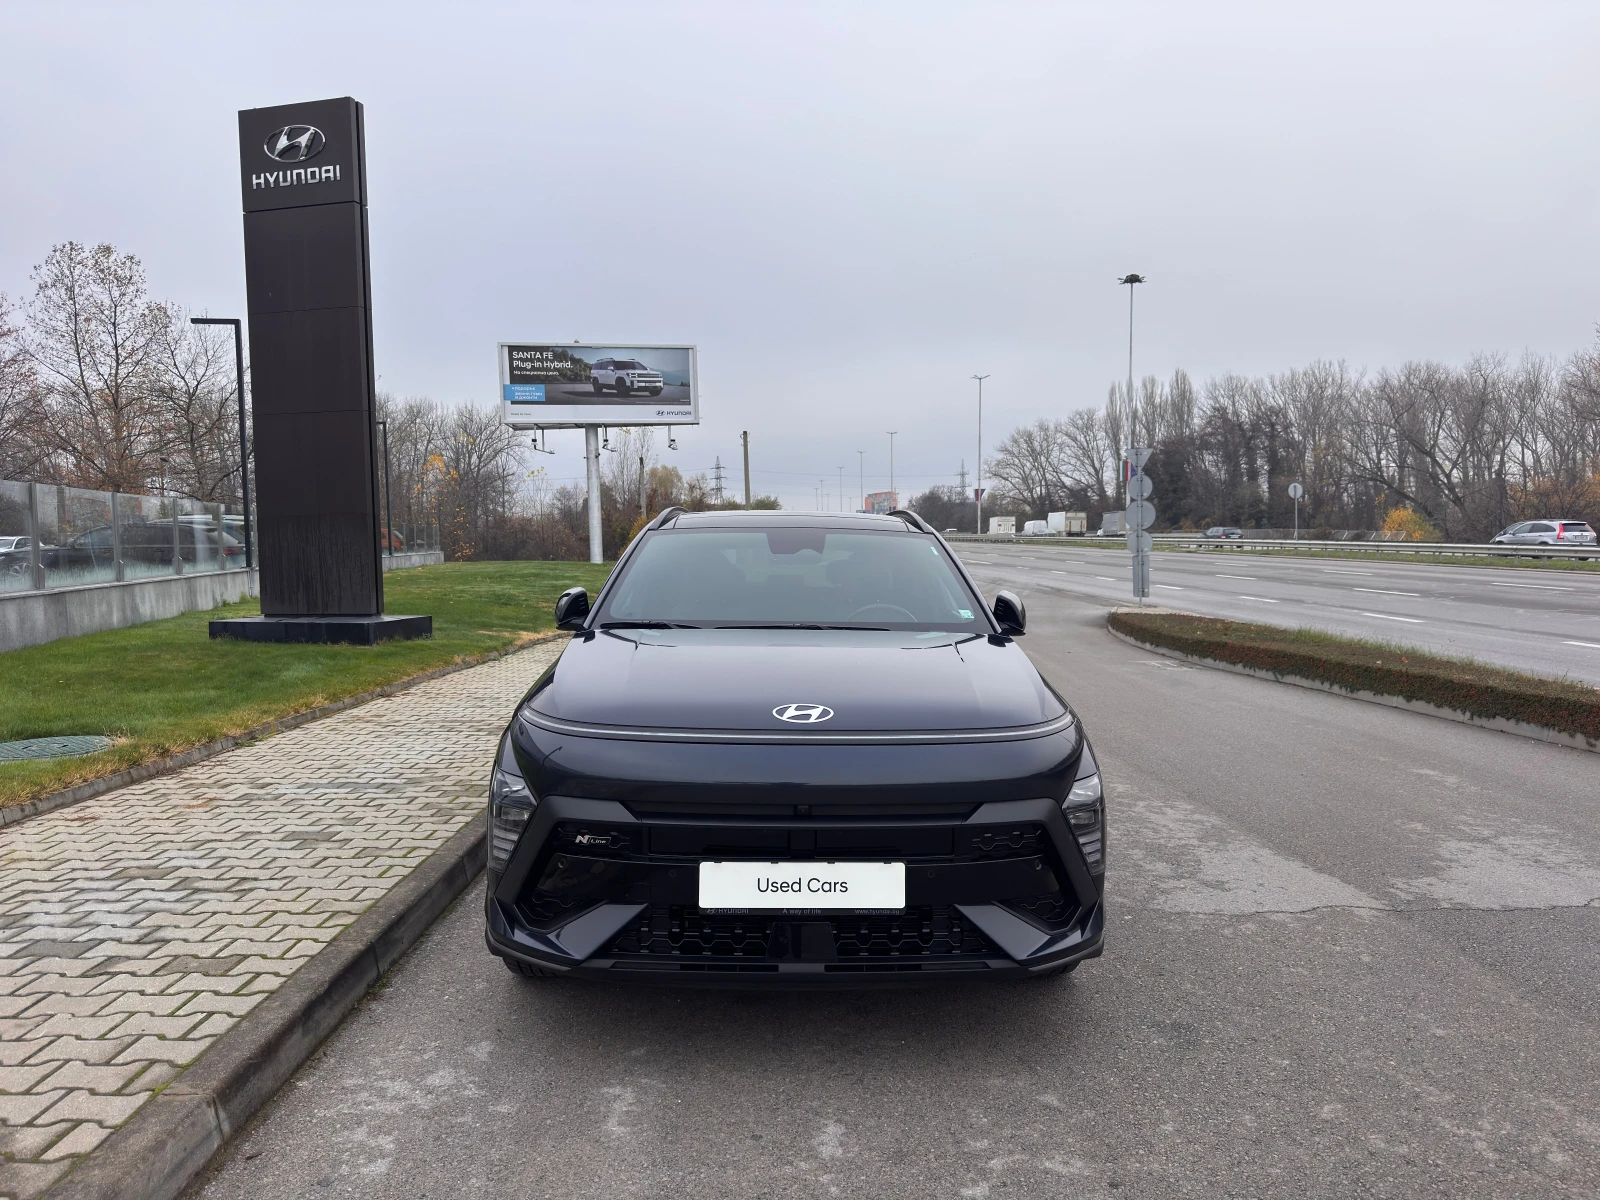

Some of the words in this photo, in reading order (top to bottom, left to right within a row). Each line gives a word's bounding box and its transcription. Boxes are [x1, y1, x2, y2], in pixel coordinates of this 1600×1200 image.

[252, 165, 340, 189] HYUNDAI
[512, 351, 541, 359] SANTA
[513, 361, 542, 369] Plug-in
[544, 361, 573, 369] Hybrid.
[757, 877, 801, 893] Used
[807, 877, 848, 893] Cars
